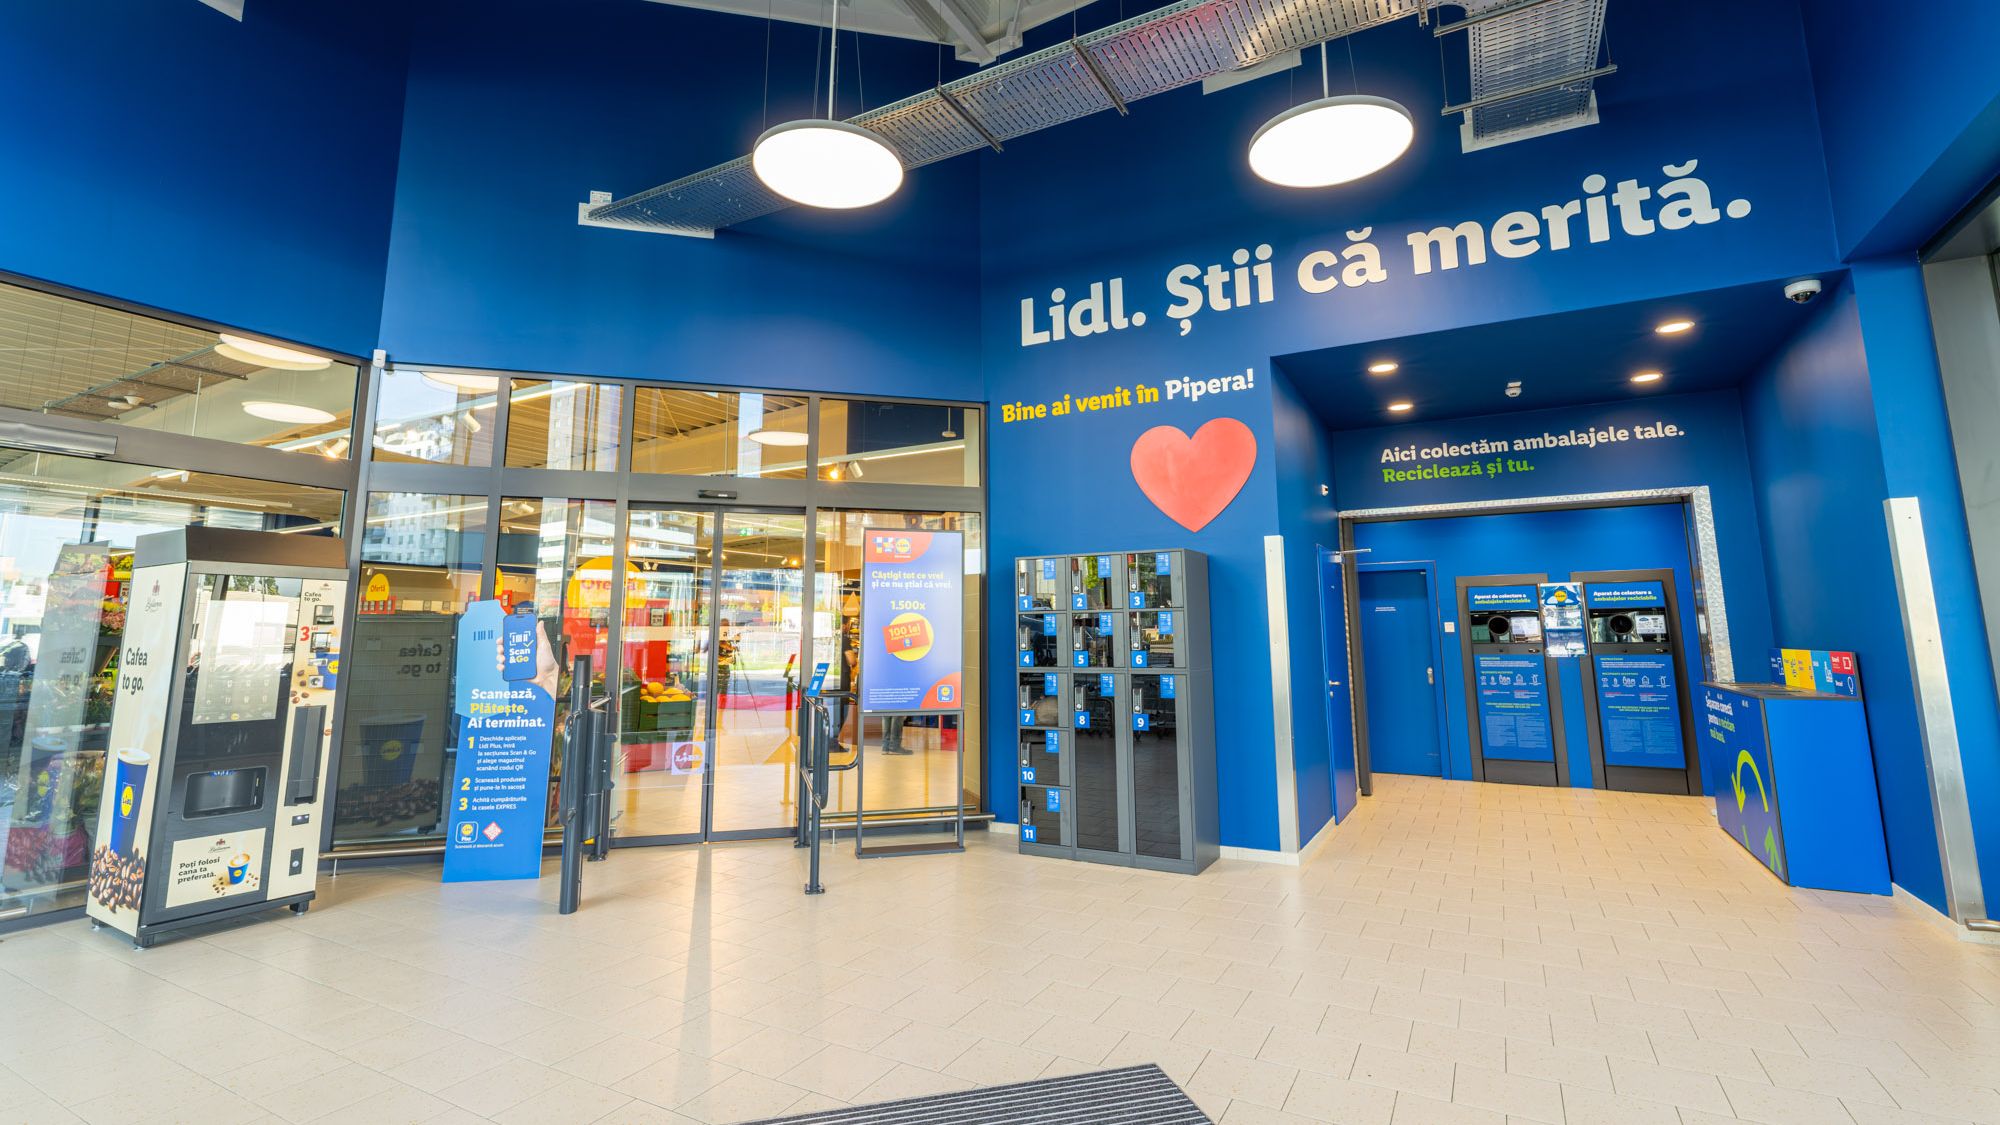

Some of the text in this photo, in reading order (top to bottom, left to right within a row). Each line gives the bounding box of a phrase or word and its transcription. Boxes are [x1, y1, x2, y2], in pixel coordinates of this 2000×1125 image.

[1021, 159, 1751, 347] Lidl. Știi că merită.
[1001, 368, 1254, 423] Bine ai venit în Pipera!
[1380, 421, 1685, 463] Aici colectăm ambalajele tale.
[1382, 457, 1535, 483] Reciclează și tu.
[871, 569, 901, 580] Căștigi
[928, 571, 944, 579] vrei
[890, 600, 926, 610] 1.500x
[1023, 599, 1028, 608] 1
[1076, 597, 1083, 607] 2
[1134, 596, 1141, 606] 3
[299, 625, 310, 642] 3
[888, 625, 907, 637] 100
[908, 623, 921, 633] lei
[125, 647, 148, 666] Cafea
[509, 655, 529, 664] &Go
[1023, 655, 1030, 664] 4
[1078, 655, 1084, 664] 5
[1135, 655, 1142, 664] 6
[122, 673, 144, 695] to go.
[471, 688, 536, 700] Scanează,
[469, 702, 528, 717] Plătește,
[467, 716, 546, 729] Ai terminat.
[1024, 713, 1031, 722] 7
[1079, 715, 1086, 725] 8
[1137, 717, 1145, 727] 9
[467, 736, 475, 749] 1
[1022, 771, 1034, 781] 10
[461, 777, 471, 791] 2
[459, 797, 468, 811] 3
[1024, 829, 1034, 839] 11
[179, 856, 220, 869] Poți folosi
[177, 872, 217, 885] preferată.
[178, 869, 198, 877] cana
